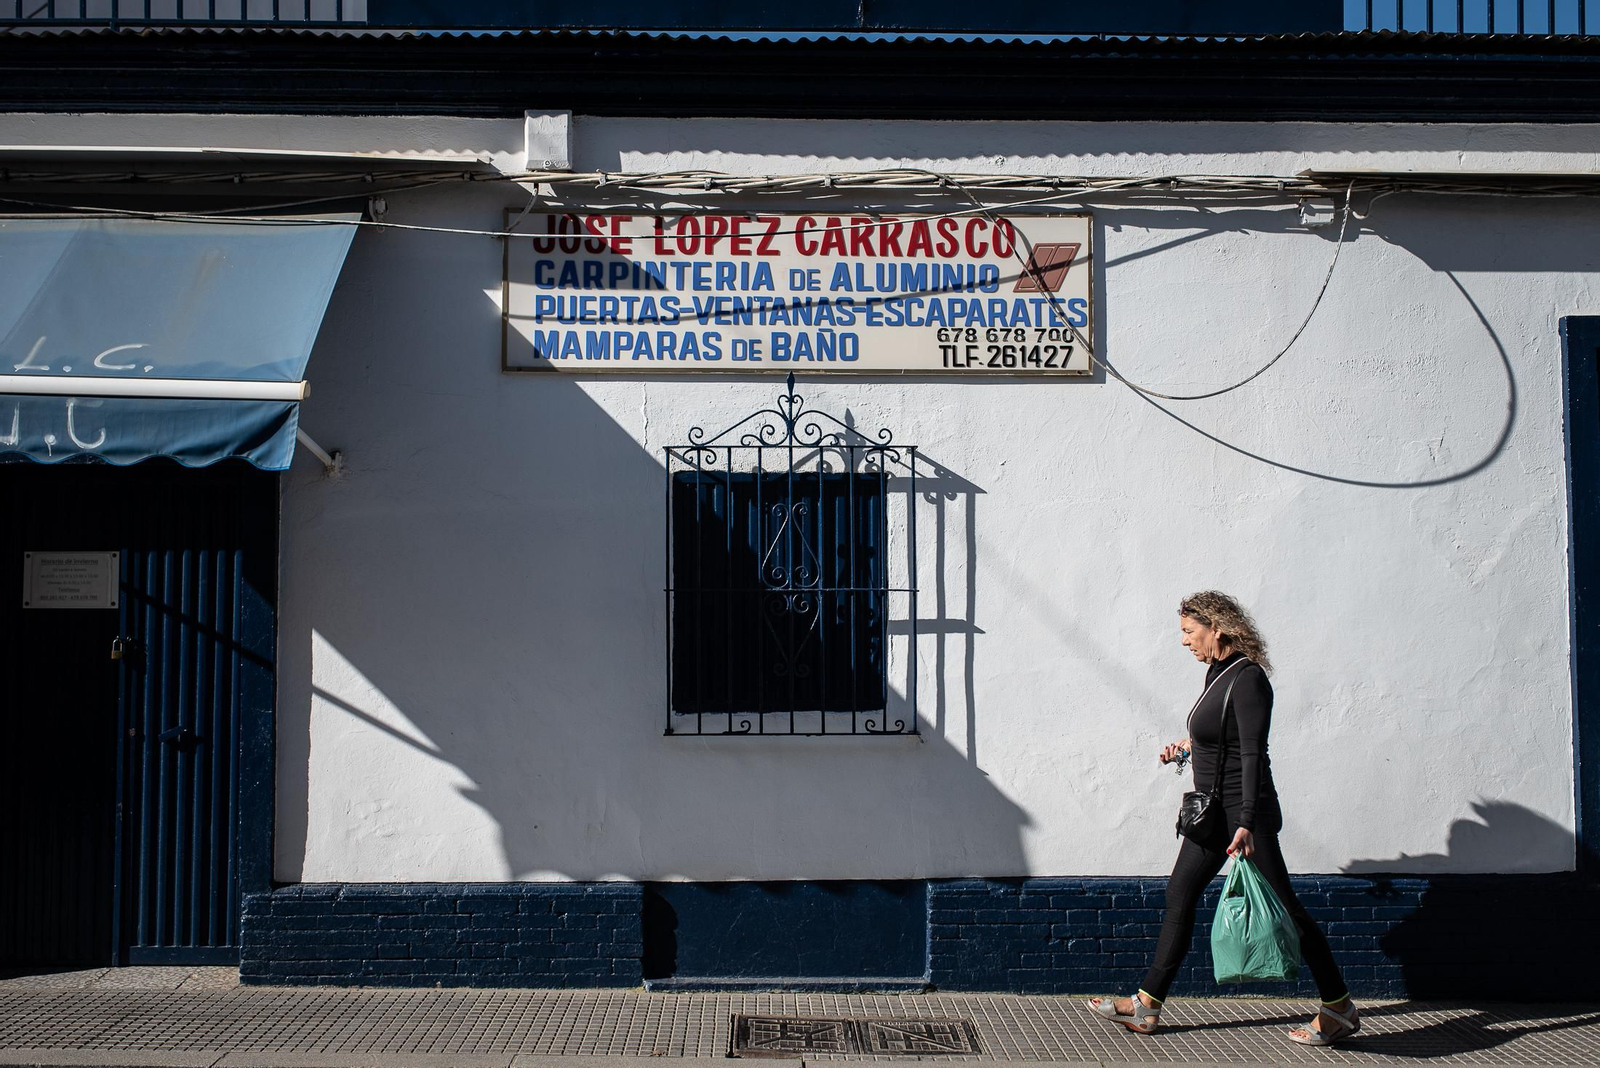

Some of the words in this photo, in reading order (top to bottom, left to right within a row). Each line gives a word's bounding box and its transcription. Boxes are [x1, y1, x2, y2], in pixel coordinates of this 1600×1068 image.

[794, 215, 1016, 258] CARRASCO
[534, 259, 775, 292] CARPINTERIA
[789, 267, 821, 292] DE
[830, 261, 1000, 294] ALUMINIO
[533, 329, 722, 362] MAMPARAS
[731, 338, 763, 362] DE
[770, 328, 860, 362] BAÑO
[936, 327, 978, 343] 678
[985, 328, 1026, 344] 678
[1034, 328, 1075, 344] 700
[986, 345, 1075, 369] 261427
